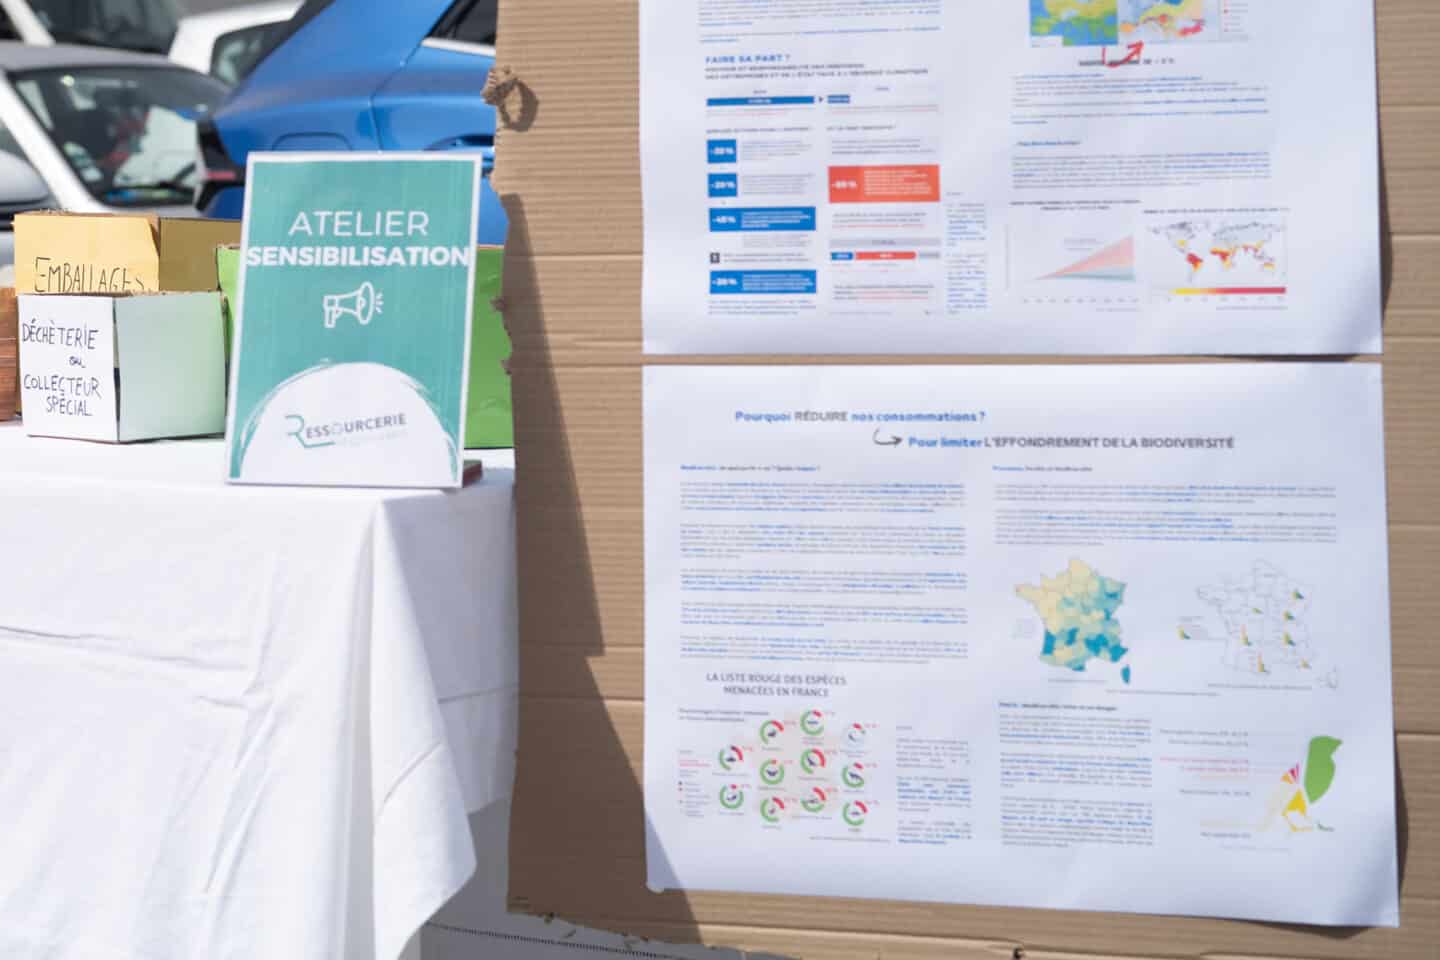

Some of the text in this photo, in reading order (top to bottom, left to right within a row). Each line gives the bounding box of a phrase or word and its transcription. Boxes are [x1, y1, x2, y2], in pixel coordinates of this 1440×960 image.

[288, 210, 429, 237] ATELIER
[246, 245, 470, 267] SENSIBILISATION
[23, 373, 102, 399] COLLECTEUR
[734, 410, 791, 424] Pourquoi
[794, 410, 848, 423] RÉDUIRE
[851, 413, 874, 423] nos
[876, 411, 977, 423] consommations
[908, 436, 937, 449] Pour
[940, 436, 984, 449] limiter
[1102, 437, 1119, 449] DE
[1121, 437, 1137, 449] LA
[1141, 435, 1235, 450] BIODIVERSITÉ
